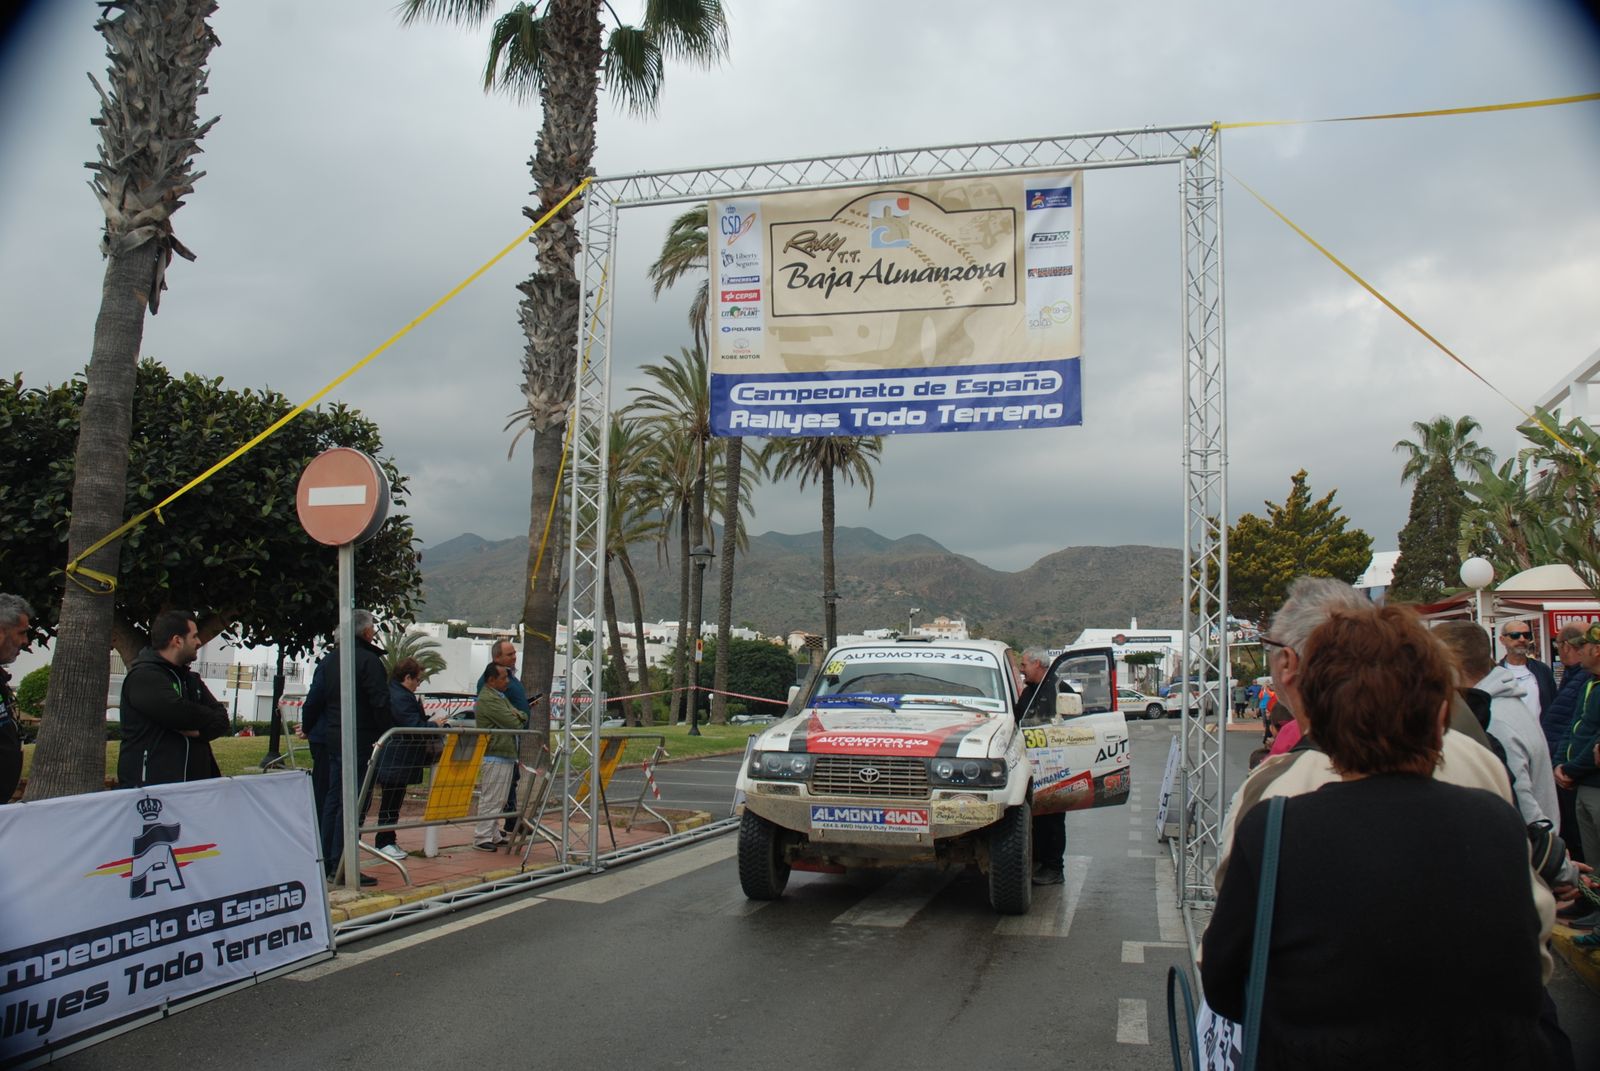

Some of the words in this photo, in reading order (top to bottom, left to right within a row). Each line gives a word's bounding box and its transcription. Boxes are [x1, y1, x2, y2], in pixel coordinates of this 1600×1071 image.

[721, 215, 741, 235] CSD
[783, 229, 847, 262] Rally
[735, 252, 757, 261] Liberty
[736, 261, 759, 269] Seguros
[838, 249, 861, 264] T.T.
[779, 262, 853, 299] Baja
[853, 258, 1006, 293] Almanzora
[737, 383, 905, 403] Campeonato
[913, 381, 947, 396] de
[955, 373, 1056, 396] España
[729, 410, 841, 434] Rallyes
[850, 407, 927, 427] Todo
[938, 403, 1064, 424] Terreno
[843, 651, 946, 661] AUTOMOTOR
[951, 653, 985, 662] 4X4
[825, 661, 844, 674] 36
[1023, 729, 1047, 748] 36
[1095, 738, 1128, 764] AUT
[813, 807, 883, 822] ALMONT
[187, 908, 215, 931] de
[222, 885, 304, 928] España
[0, 981, 109, 1038] llyes
[124, 950, 203, 995] Todo
[213, 921, 313, 967] Terreno
